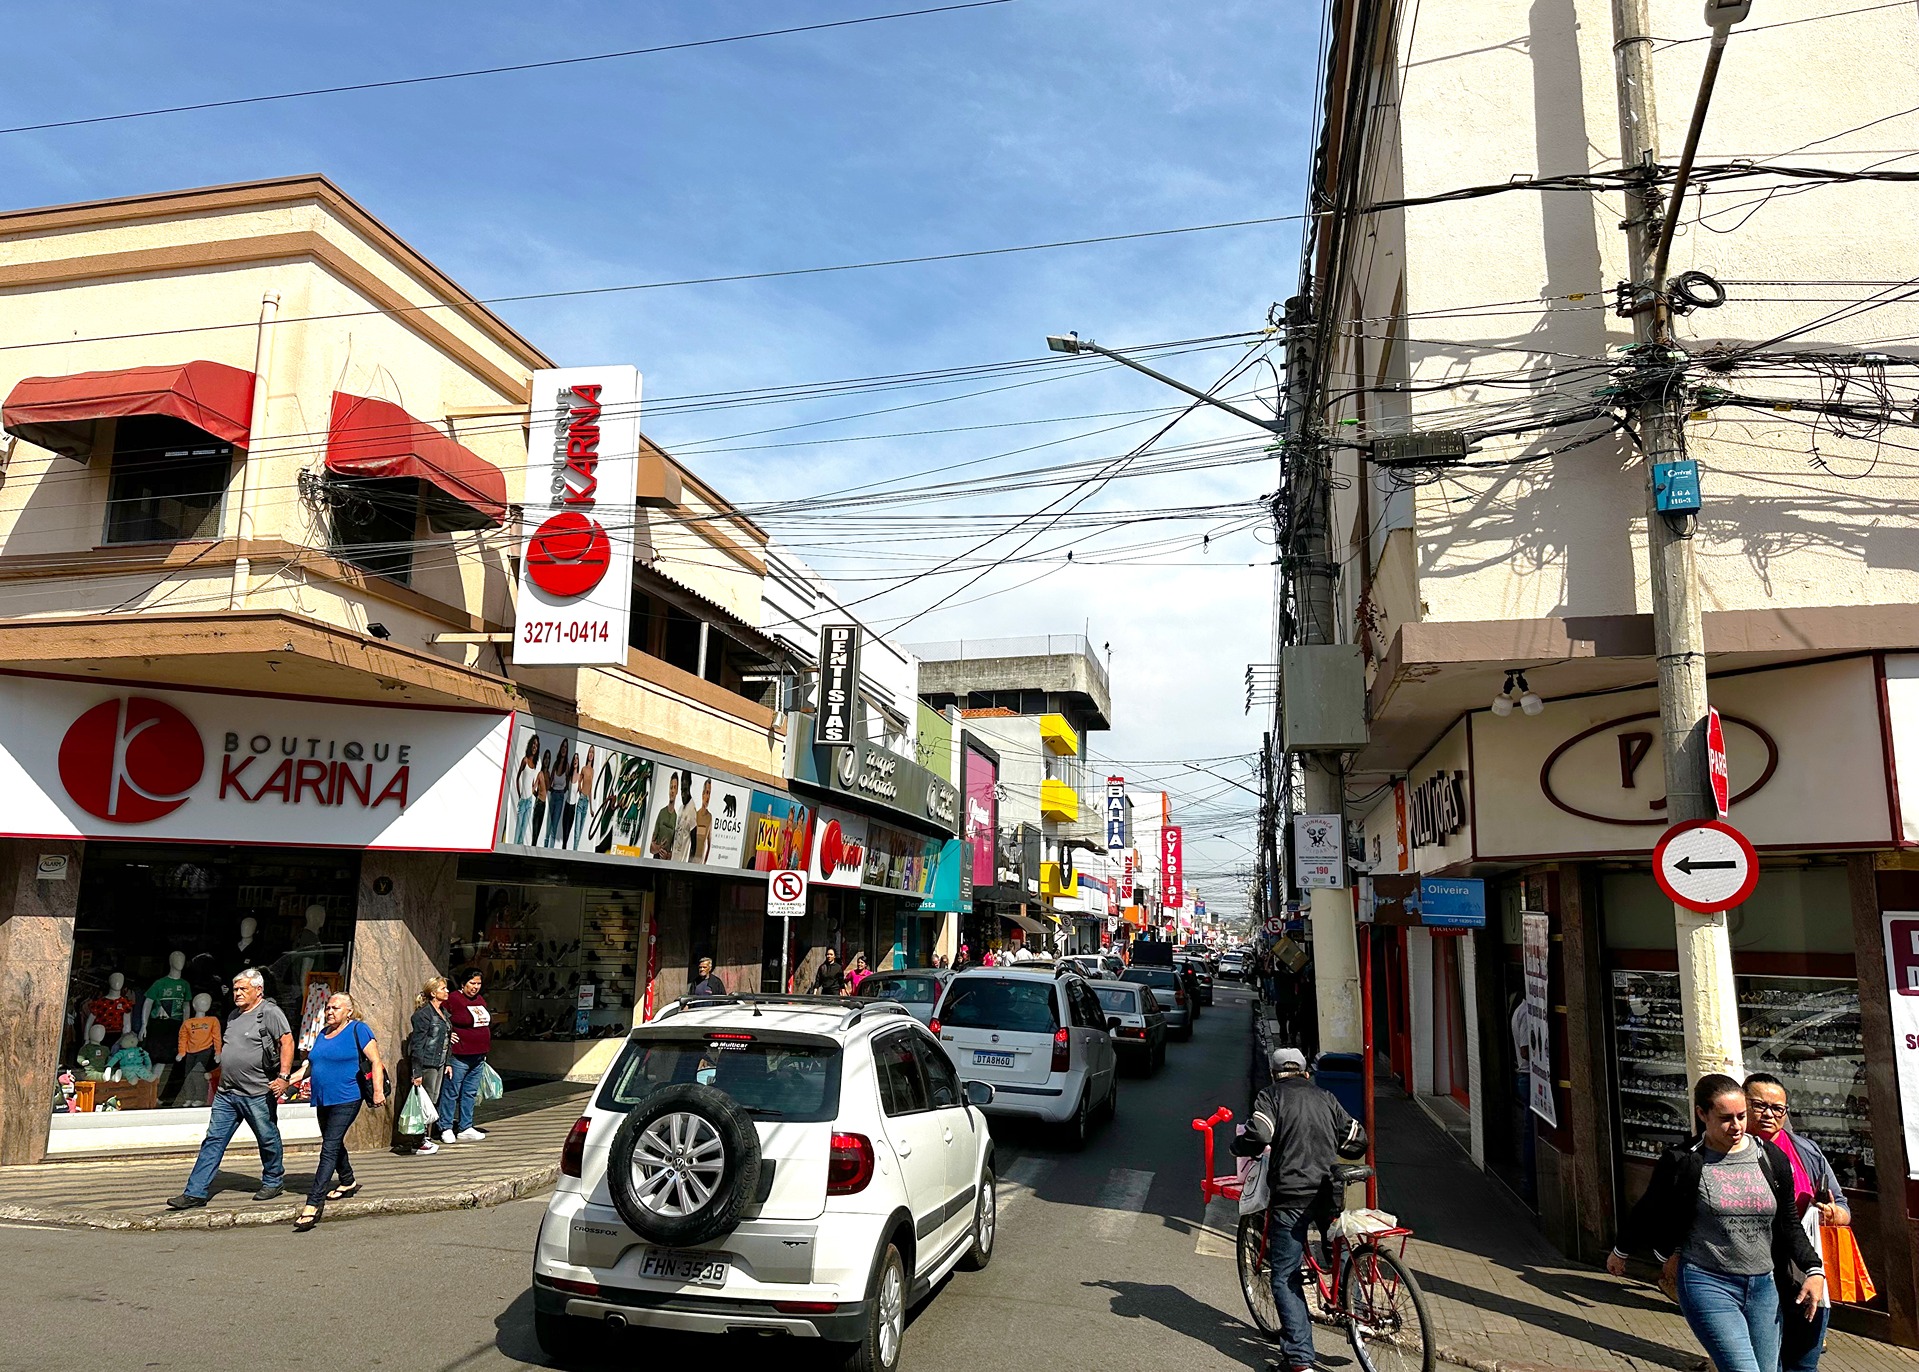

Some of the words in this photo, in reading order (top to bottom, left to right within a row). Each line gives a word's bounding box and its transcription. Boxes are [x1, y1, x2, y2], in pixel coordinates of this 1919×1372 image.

[551, 388, 572, 506] BOUTIQUE
[564, 384, 602, 503] KARINA
[523, 620, 609, 643] 3271-0414
[825, 629, 849, 740] DENTISTAS
[224, 732, 411, 764] BOUTIQUE
[1709, 749, 1728, 778] PARE
[219, 754, 410, 808] KARINA
[713, 817, 742, 834] BIOGÁS
[1108, 786, 1124, 846] BAHIA
[1301, 819, 1333, 829] VIZINHANÇA
[757, 821, 779, 849] KYLY
[1125, 856, 1133, 884] DINIZ
[1166, 831, 1177, 904] Cybelar
[1316, 867, 1329, 875] 190
[1428, 885, 1469, 895] Oliveira
[574, 1225, 618, 1237] CROSSFOX
